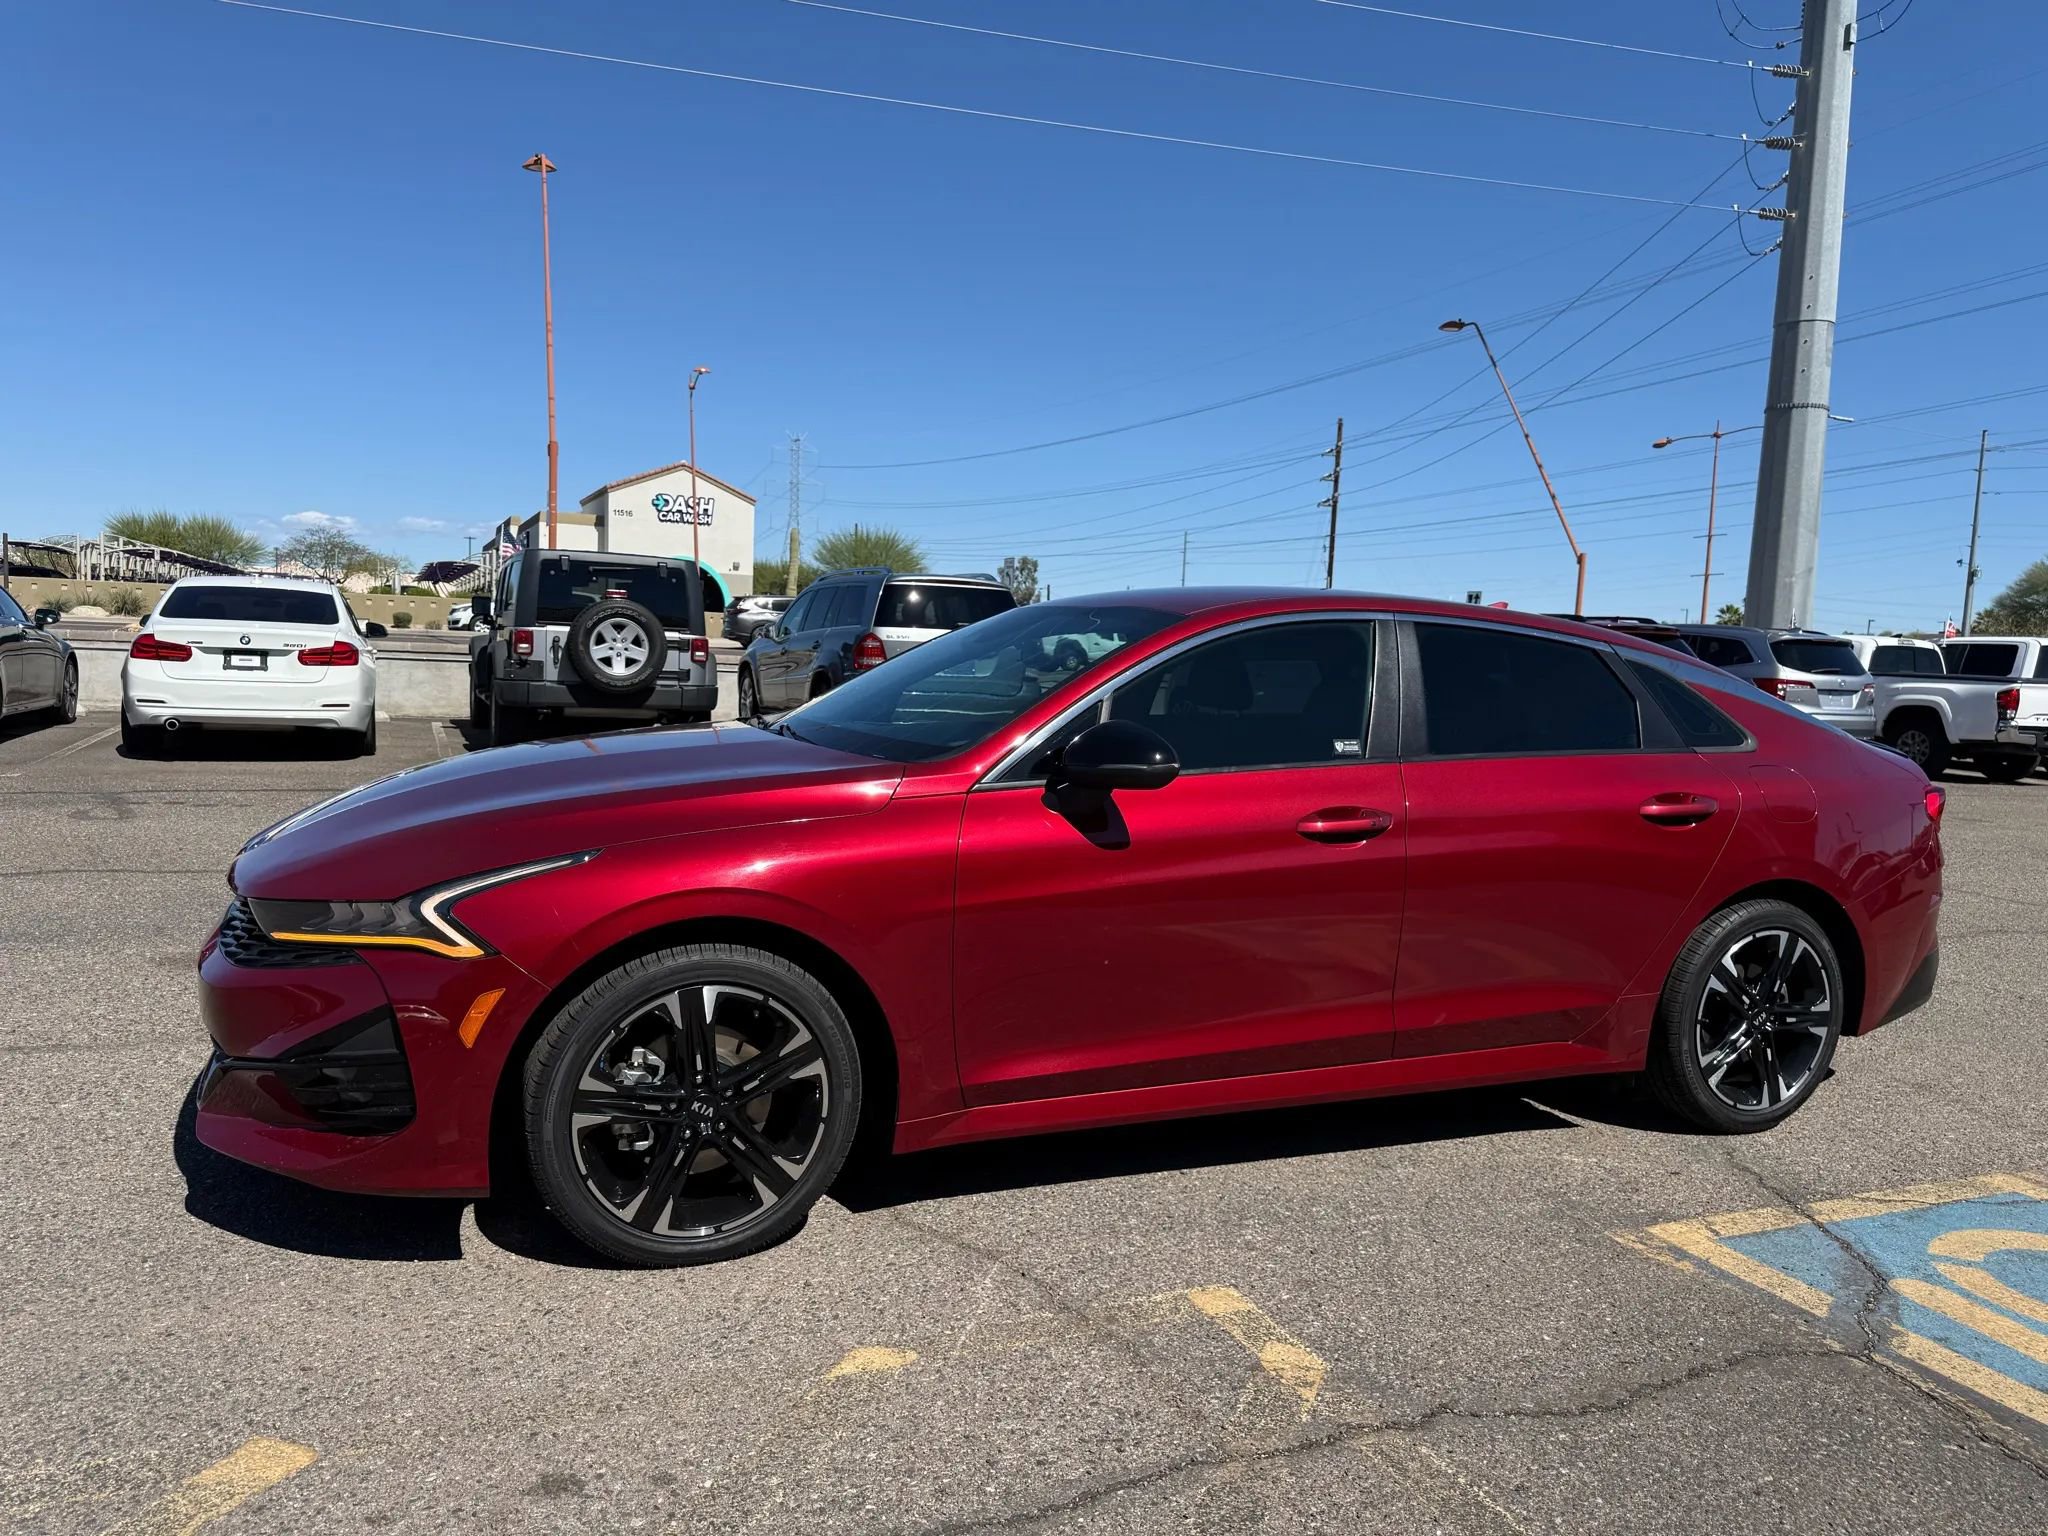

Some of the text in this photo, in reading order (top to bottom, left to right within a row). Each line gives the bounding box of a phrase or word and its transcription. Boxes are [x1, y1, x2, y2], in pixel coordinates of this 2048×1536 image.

[653, 494, 714, 515] DASH
[612, 509, 633, 518] 11516
[660, 511, 681, 521] CAR
[691, 1101, 714, 1118] KIA
